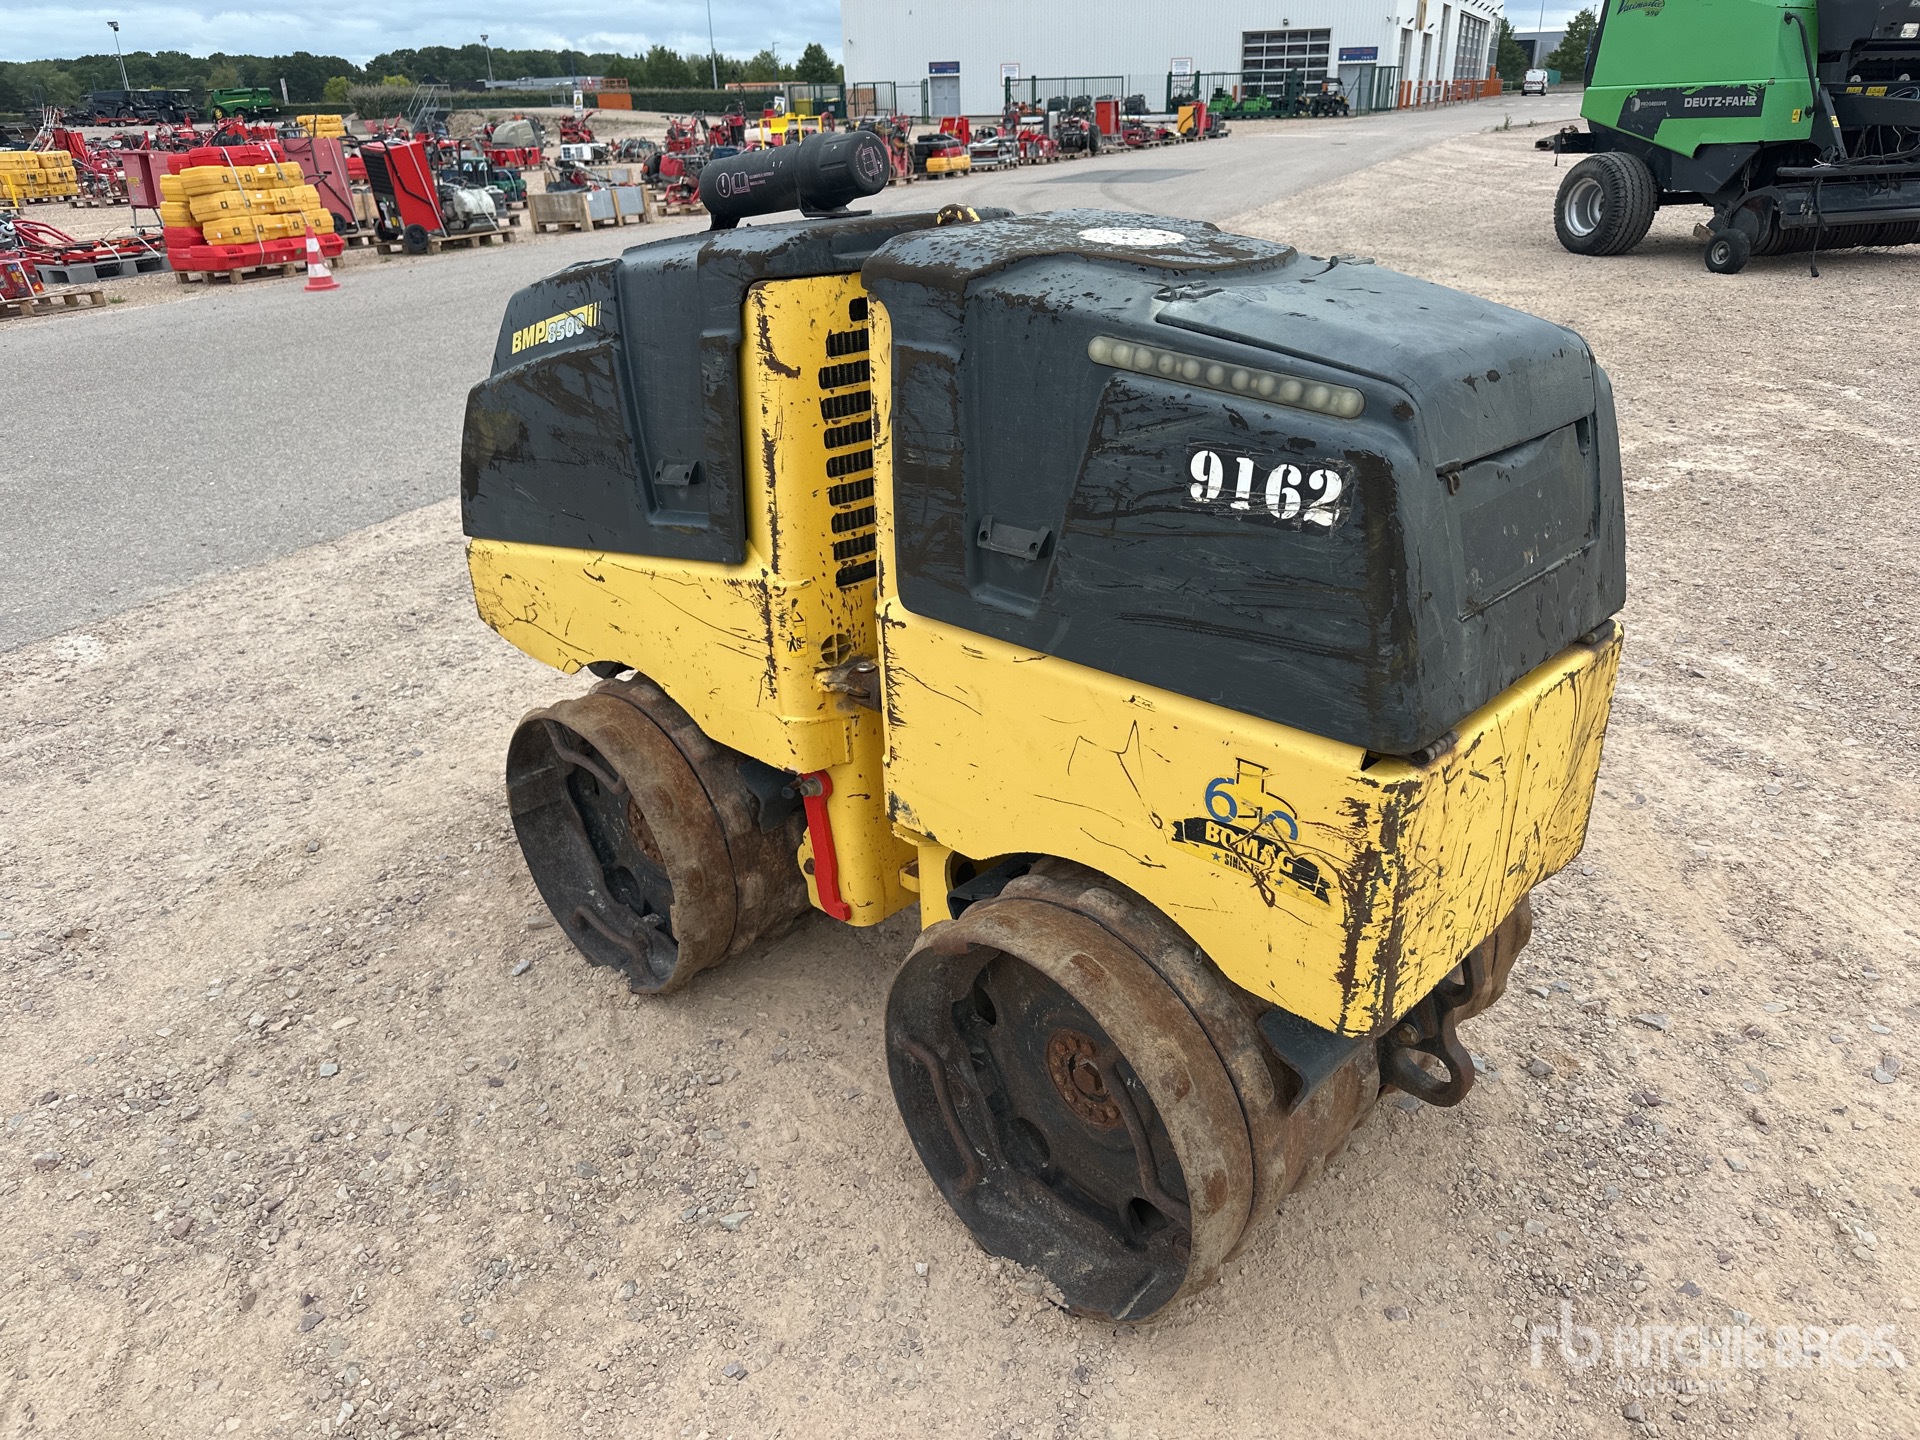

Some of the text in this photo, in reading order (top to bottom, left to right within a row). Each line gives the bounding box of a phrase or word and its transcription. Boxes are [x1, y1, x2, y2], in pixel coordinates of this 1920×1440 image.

[1684, 95, 1758, 108] DEUTZ-FAHR
[1190, 450, 1343, 527] 9162
[1205, 819, 1294, 875] BOMAG
